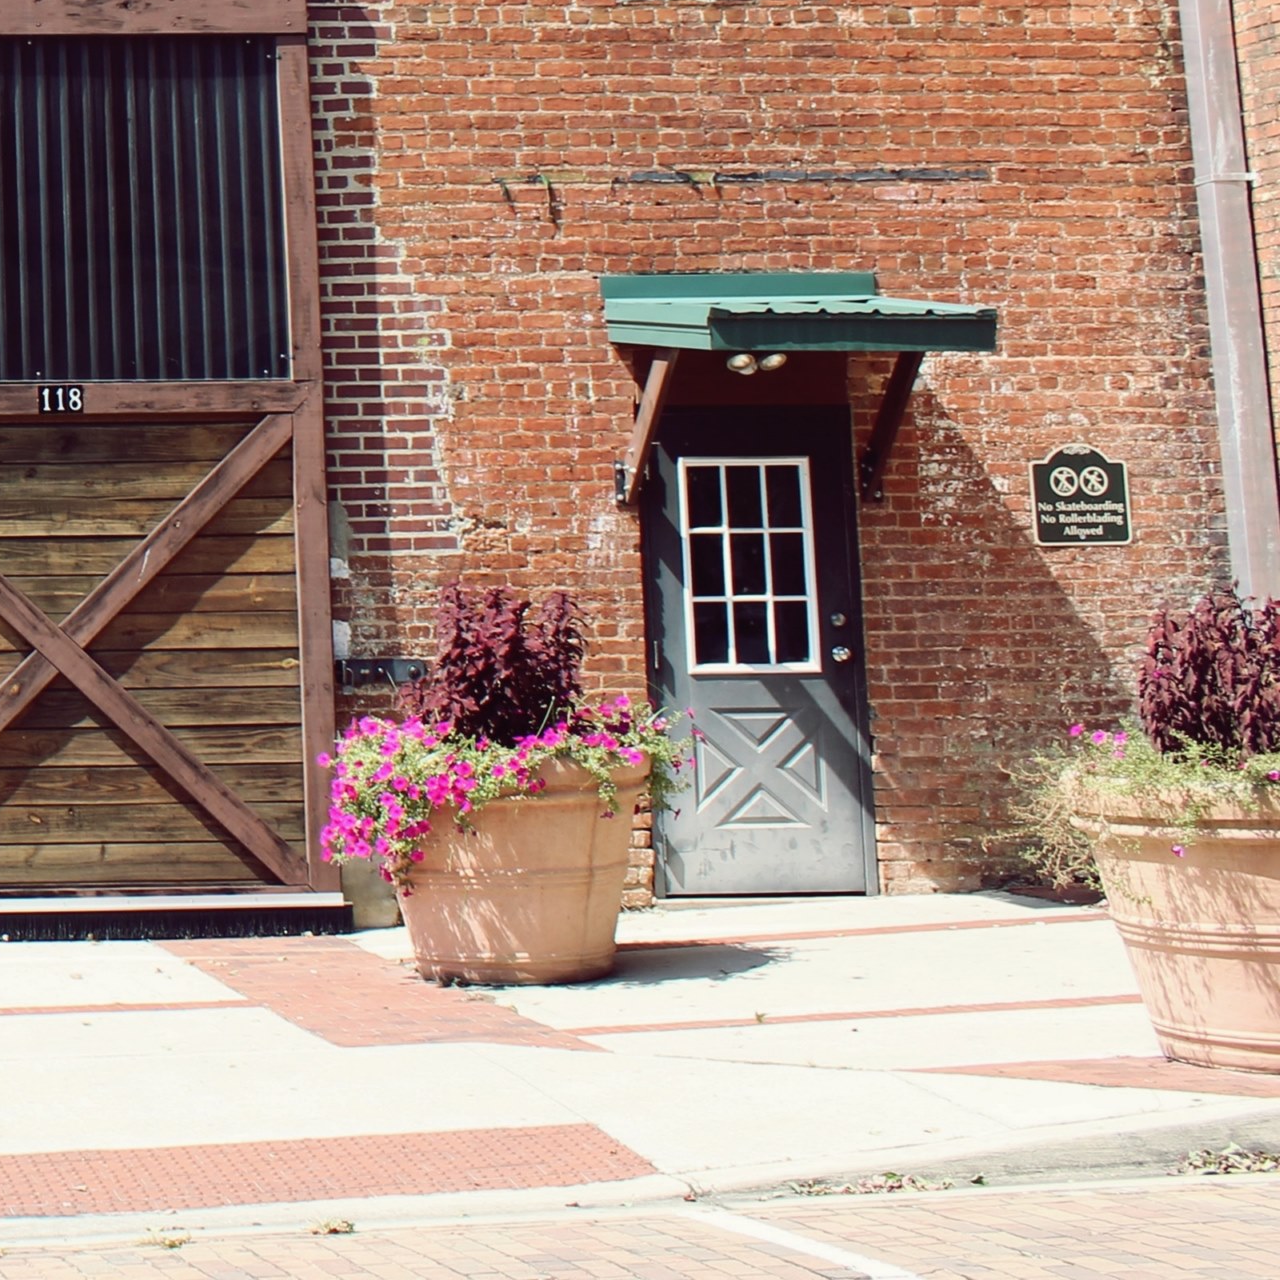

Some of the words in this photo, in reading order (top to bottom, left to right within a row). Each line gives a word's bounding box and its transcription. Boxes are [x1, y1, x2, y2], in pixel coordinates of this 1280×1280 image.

[42, 387, 82, 411] 118
[1038, 502, 1053, 511] No
[1055, 500, 1125, 513] Skateboarding
[1041, 514, 1056, 523] No
[1058, 513, 1124, 525] Rollerblading
[1063, 525, 1104, 536] Allowed
